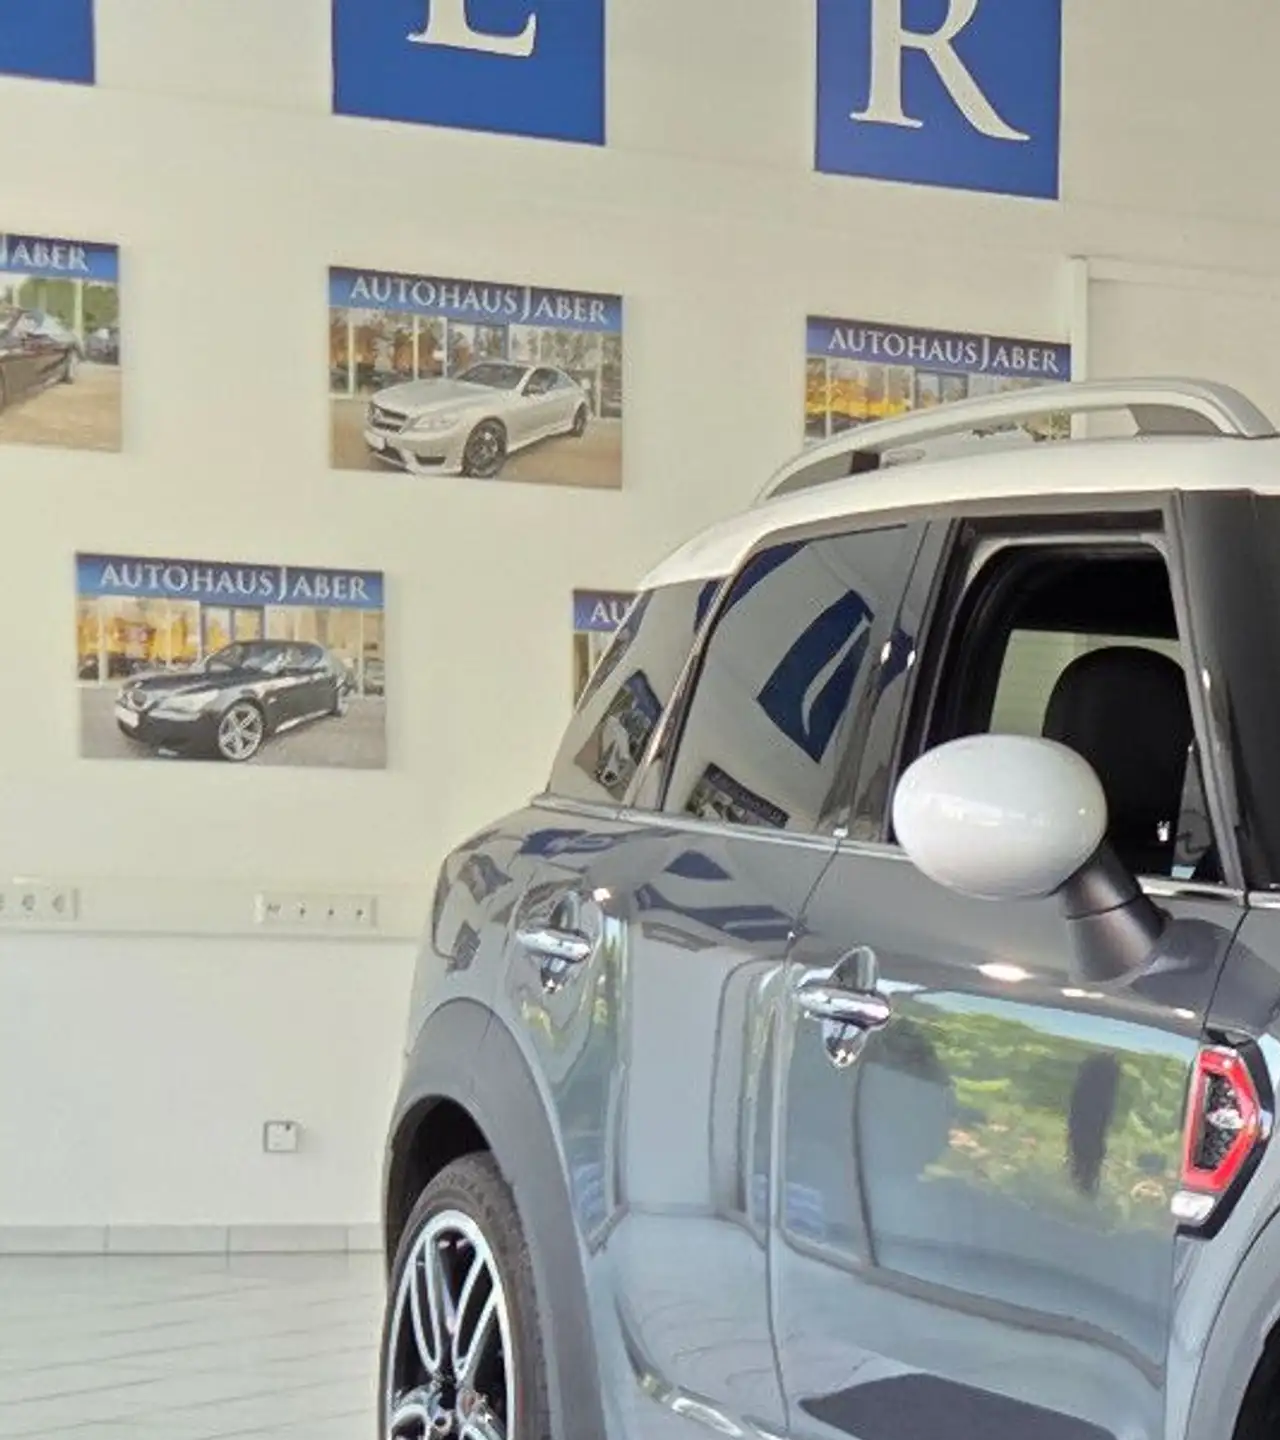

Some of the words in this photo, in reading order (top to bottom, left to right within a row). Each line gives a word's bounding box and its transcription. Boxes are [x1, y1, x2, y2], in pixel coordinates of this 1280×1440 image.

[850, 0, 1031, 140] R
[350, 276, 516, 314] AUTOHAUS
[515, 286, 610, 324] JABER
[828, 327, 977, 364] AUTOHAUS
[978, 336, 1059, 373] JABER
[100, 563, 273, 597] AUTOHAUS
[276, 566, 370, 600] JABER
